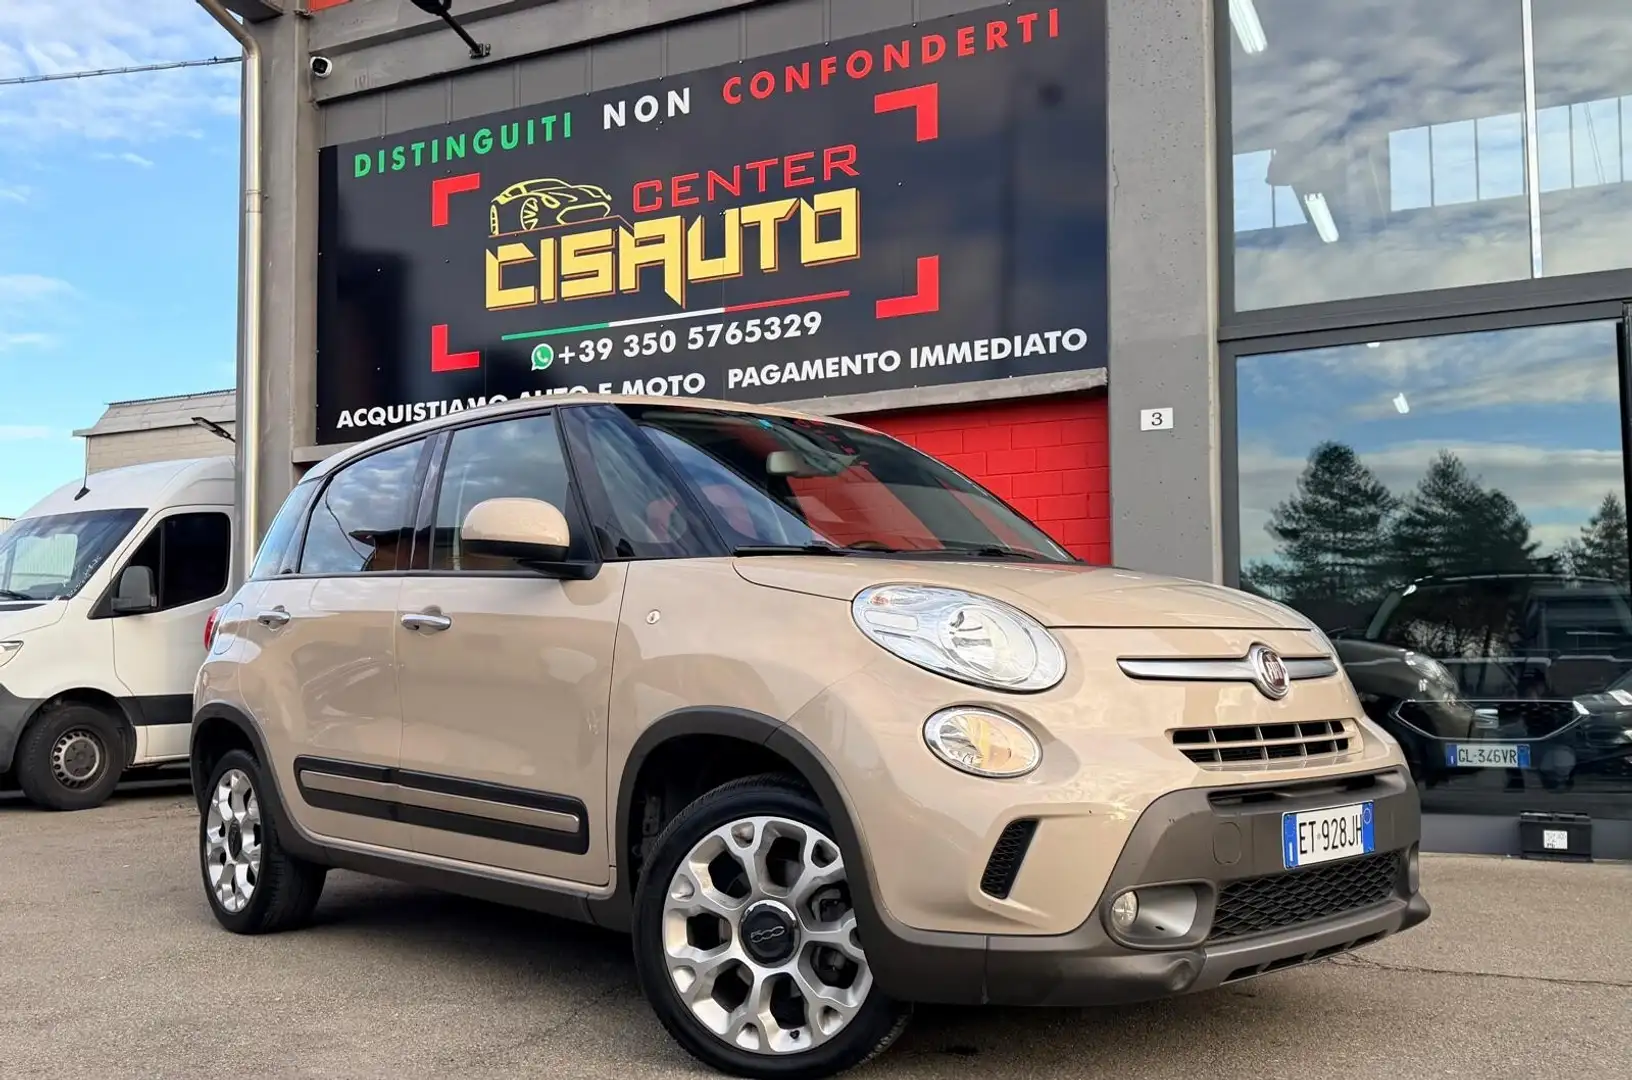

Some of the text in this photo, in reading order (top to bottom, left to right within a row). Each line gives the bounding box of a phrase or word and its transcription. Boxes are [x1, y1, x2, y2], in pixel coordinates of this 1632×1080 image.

[353, 7, 1060, 179] DISTINGUITI NON CONFONDERTI
[632, 143, 860, 214] CENTER
[485, 187, 861, 312] CISAUTO
[558, 310, 823, 365] +39 350 5765329
[621, 372, 706, 396] MOTO
[727, 349, 902, 389] PAGAMENTO
[909, 327, 1089, 369] IMMEDIATO
[1151, 411, 1163, 426] 3
